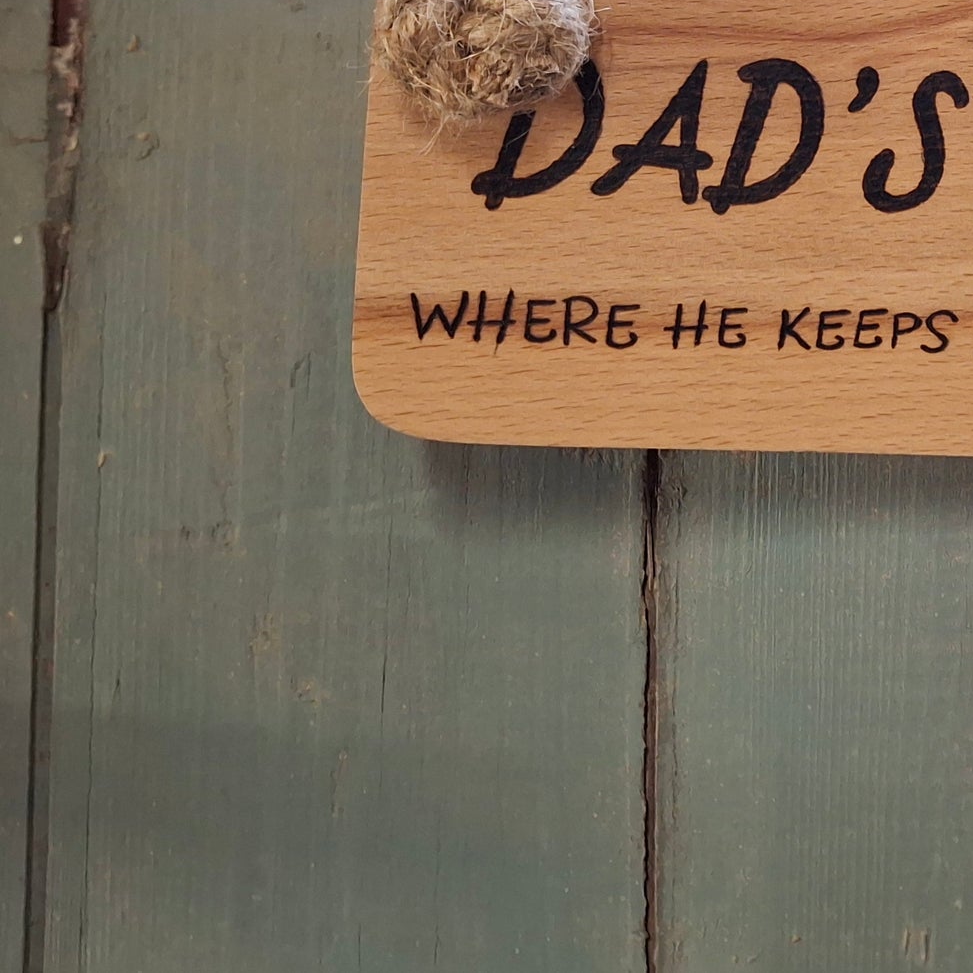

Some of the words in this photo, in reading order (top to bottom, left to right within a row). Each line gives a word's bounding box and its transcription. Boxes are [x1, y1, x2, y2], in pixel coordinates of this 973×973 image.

[470, 58, 970, 216] DAD'S
[409, 288, 641, 354] WHERE
[663, 299, 749, 351] HE
[776, 306, 960, 355] KEEPS
